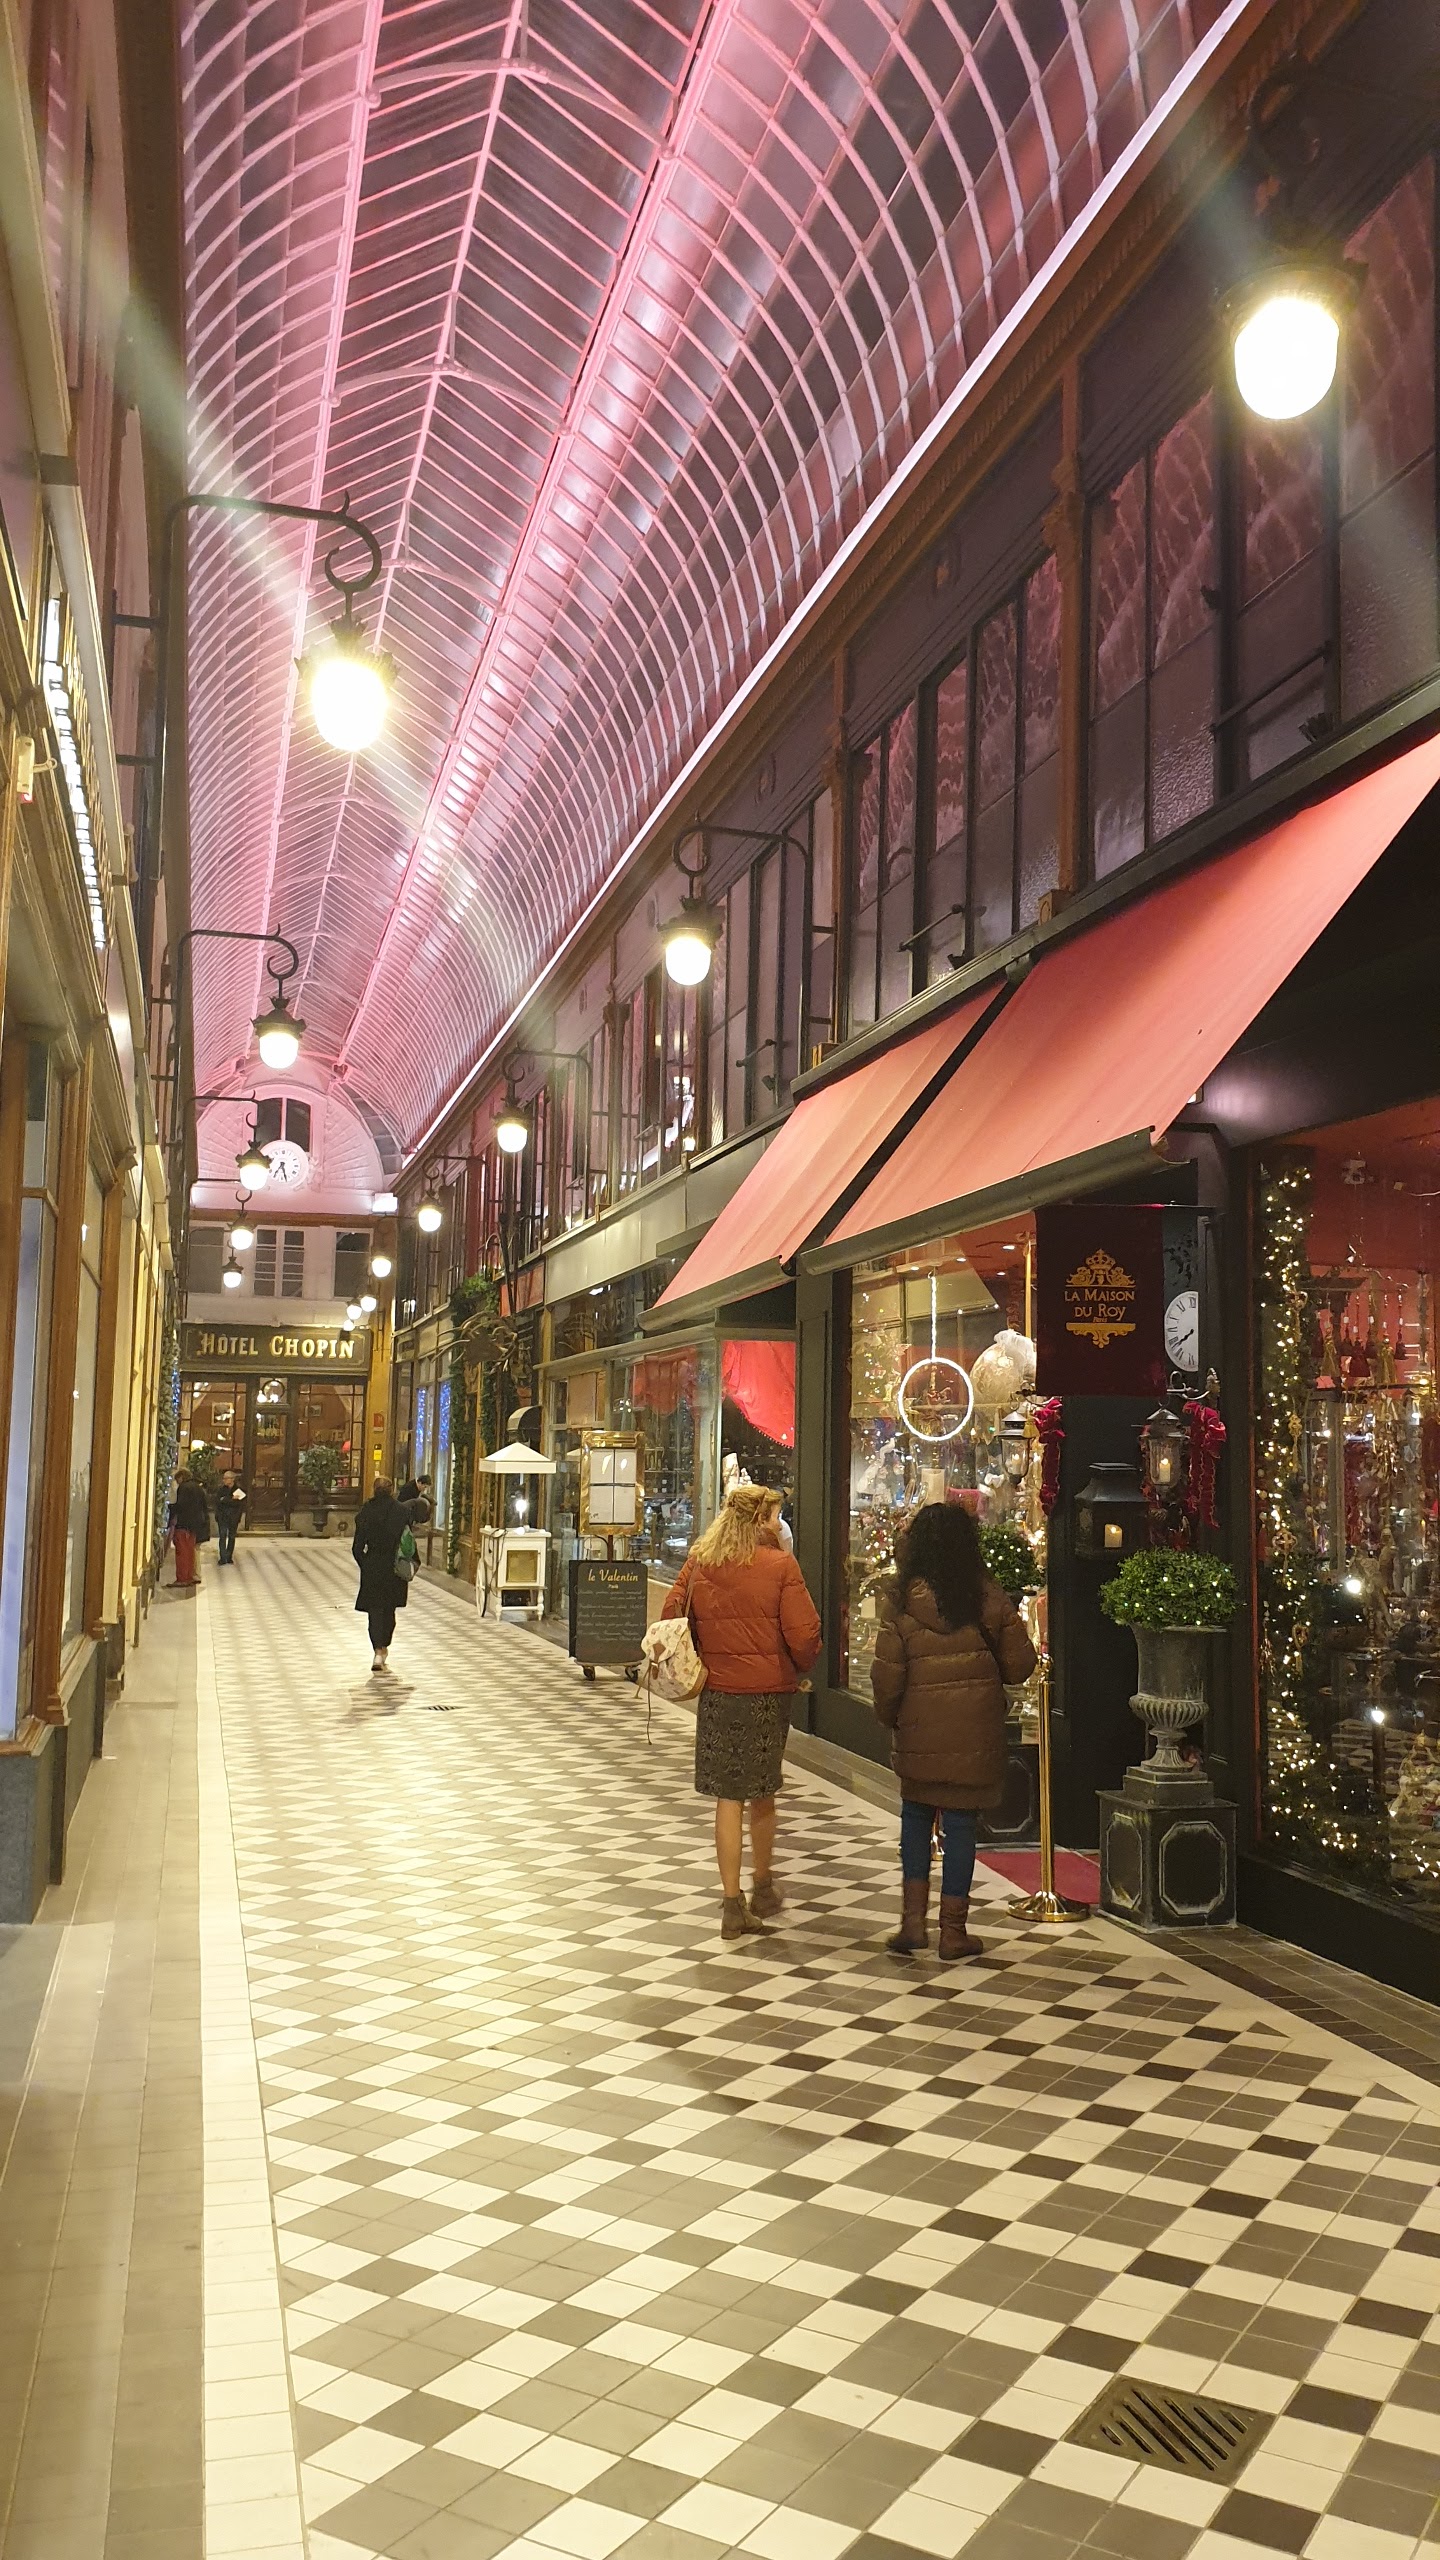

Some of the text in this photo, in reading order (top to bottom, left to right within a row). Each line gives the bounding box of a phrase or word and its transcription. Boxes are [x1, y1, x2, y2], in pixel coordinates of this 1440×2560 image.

[1064, 1288, 1135, 1301] LA MAISON
[1075, 1306, 1092, 1317] DU
[196, 1332, 355, 1359] HÔTEL CHOPIN
[599, 1568, 639, 1582] Valentin
